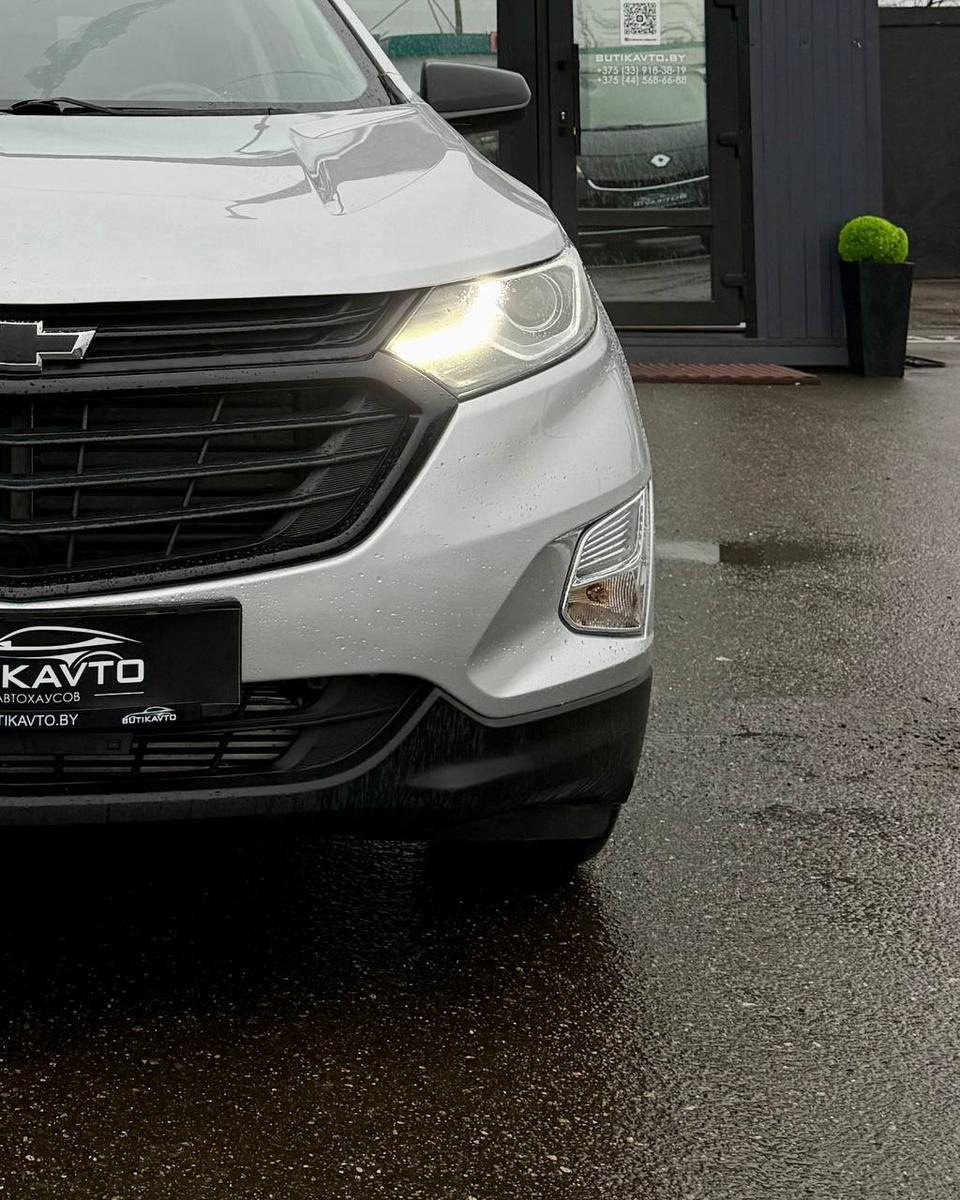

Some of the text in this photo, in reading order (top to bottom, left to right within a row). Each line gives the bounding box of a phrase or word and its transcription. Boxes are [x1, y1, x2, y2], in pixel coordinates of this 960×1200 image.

[595, 54, 686, 62] BUTIKAVTO.BY
[597, 65, 687, 76] +375 (33) 918-38-19
[597, 76, 619, 85] +375
[622, 75, 639, 86] (44)
[122, 713, 177, 725] BUTIKAVTO
